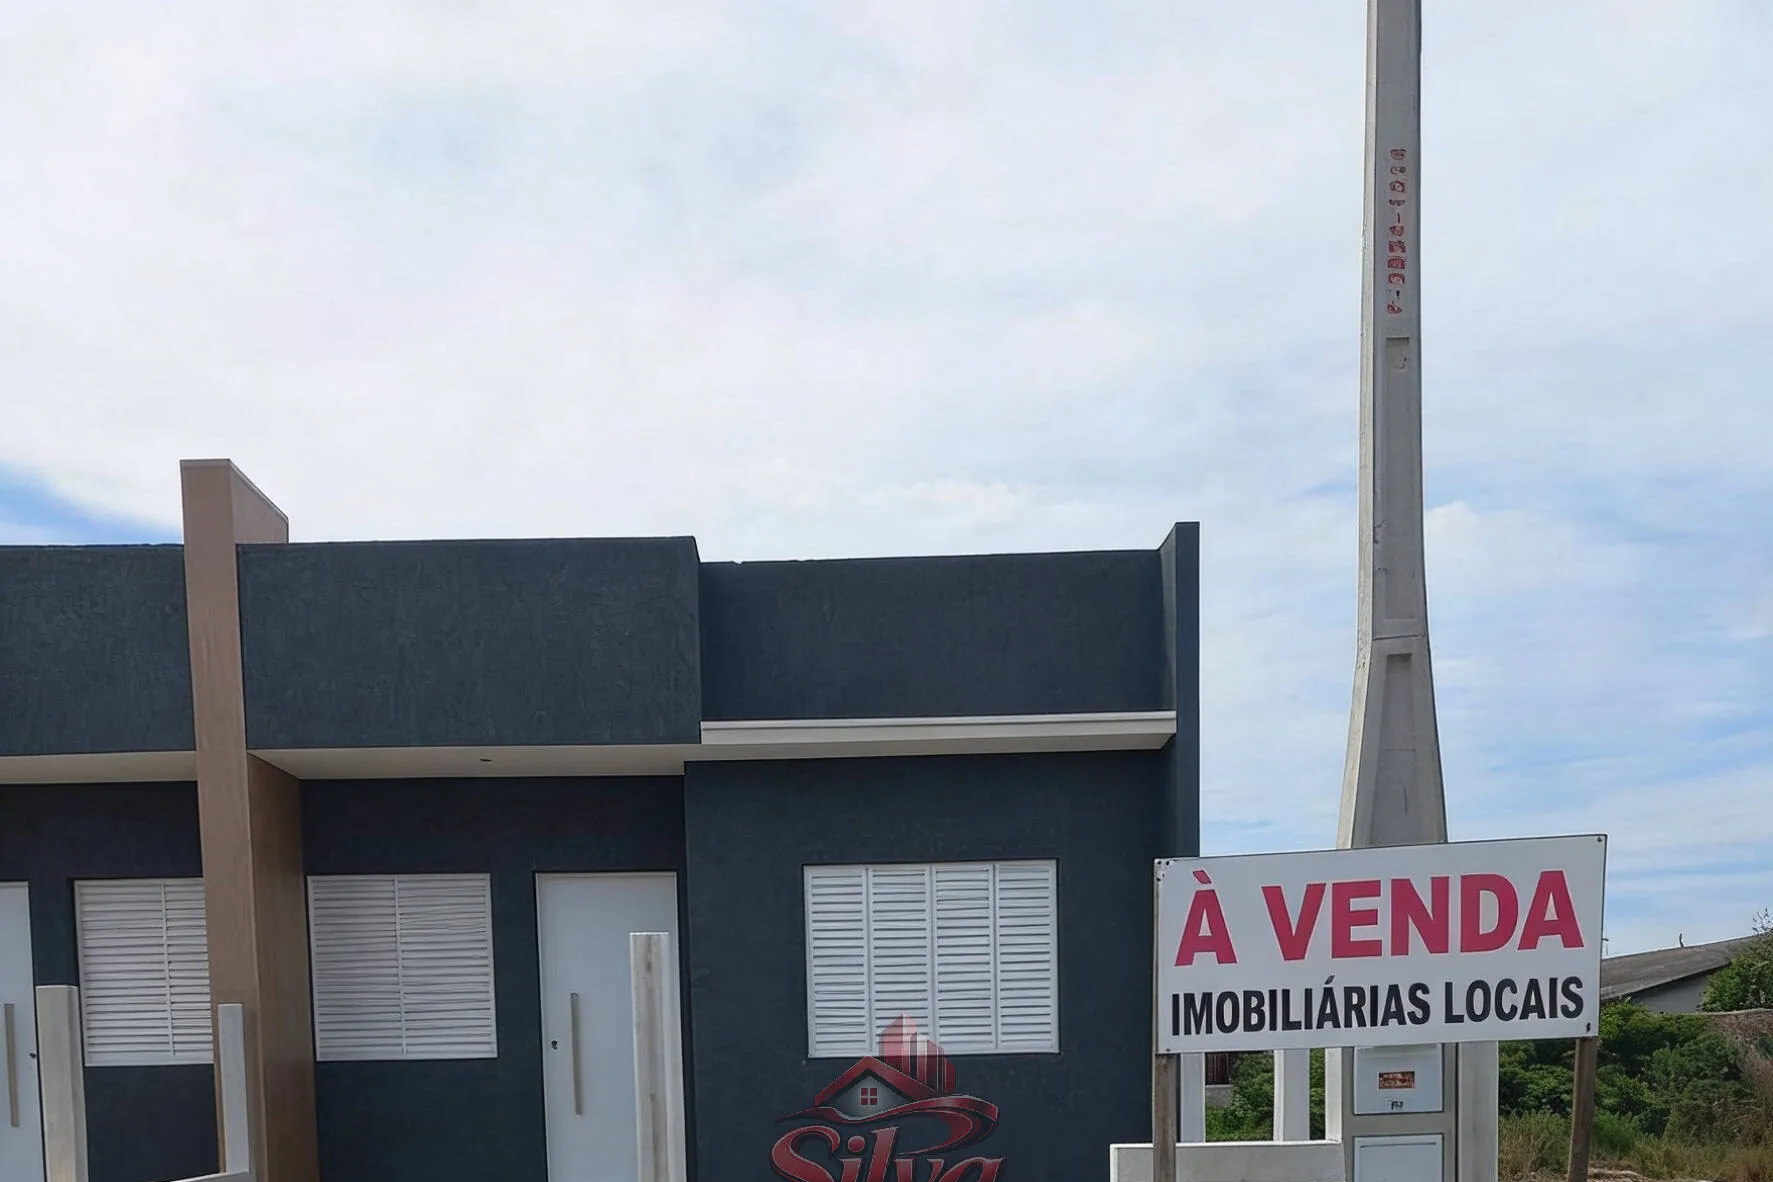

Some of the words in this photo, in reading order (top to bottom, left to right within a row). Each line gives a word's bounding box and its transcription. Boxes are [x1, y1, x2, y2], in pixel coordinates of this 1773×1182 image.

[1174, 869, 1238, 967] À
[1261, 869, 1585, 962] VENDA
[1171, 974, 1431, 1037] IMOBILIÁRIAS
[1443, 975, 1585, 1025] LOCAIS
